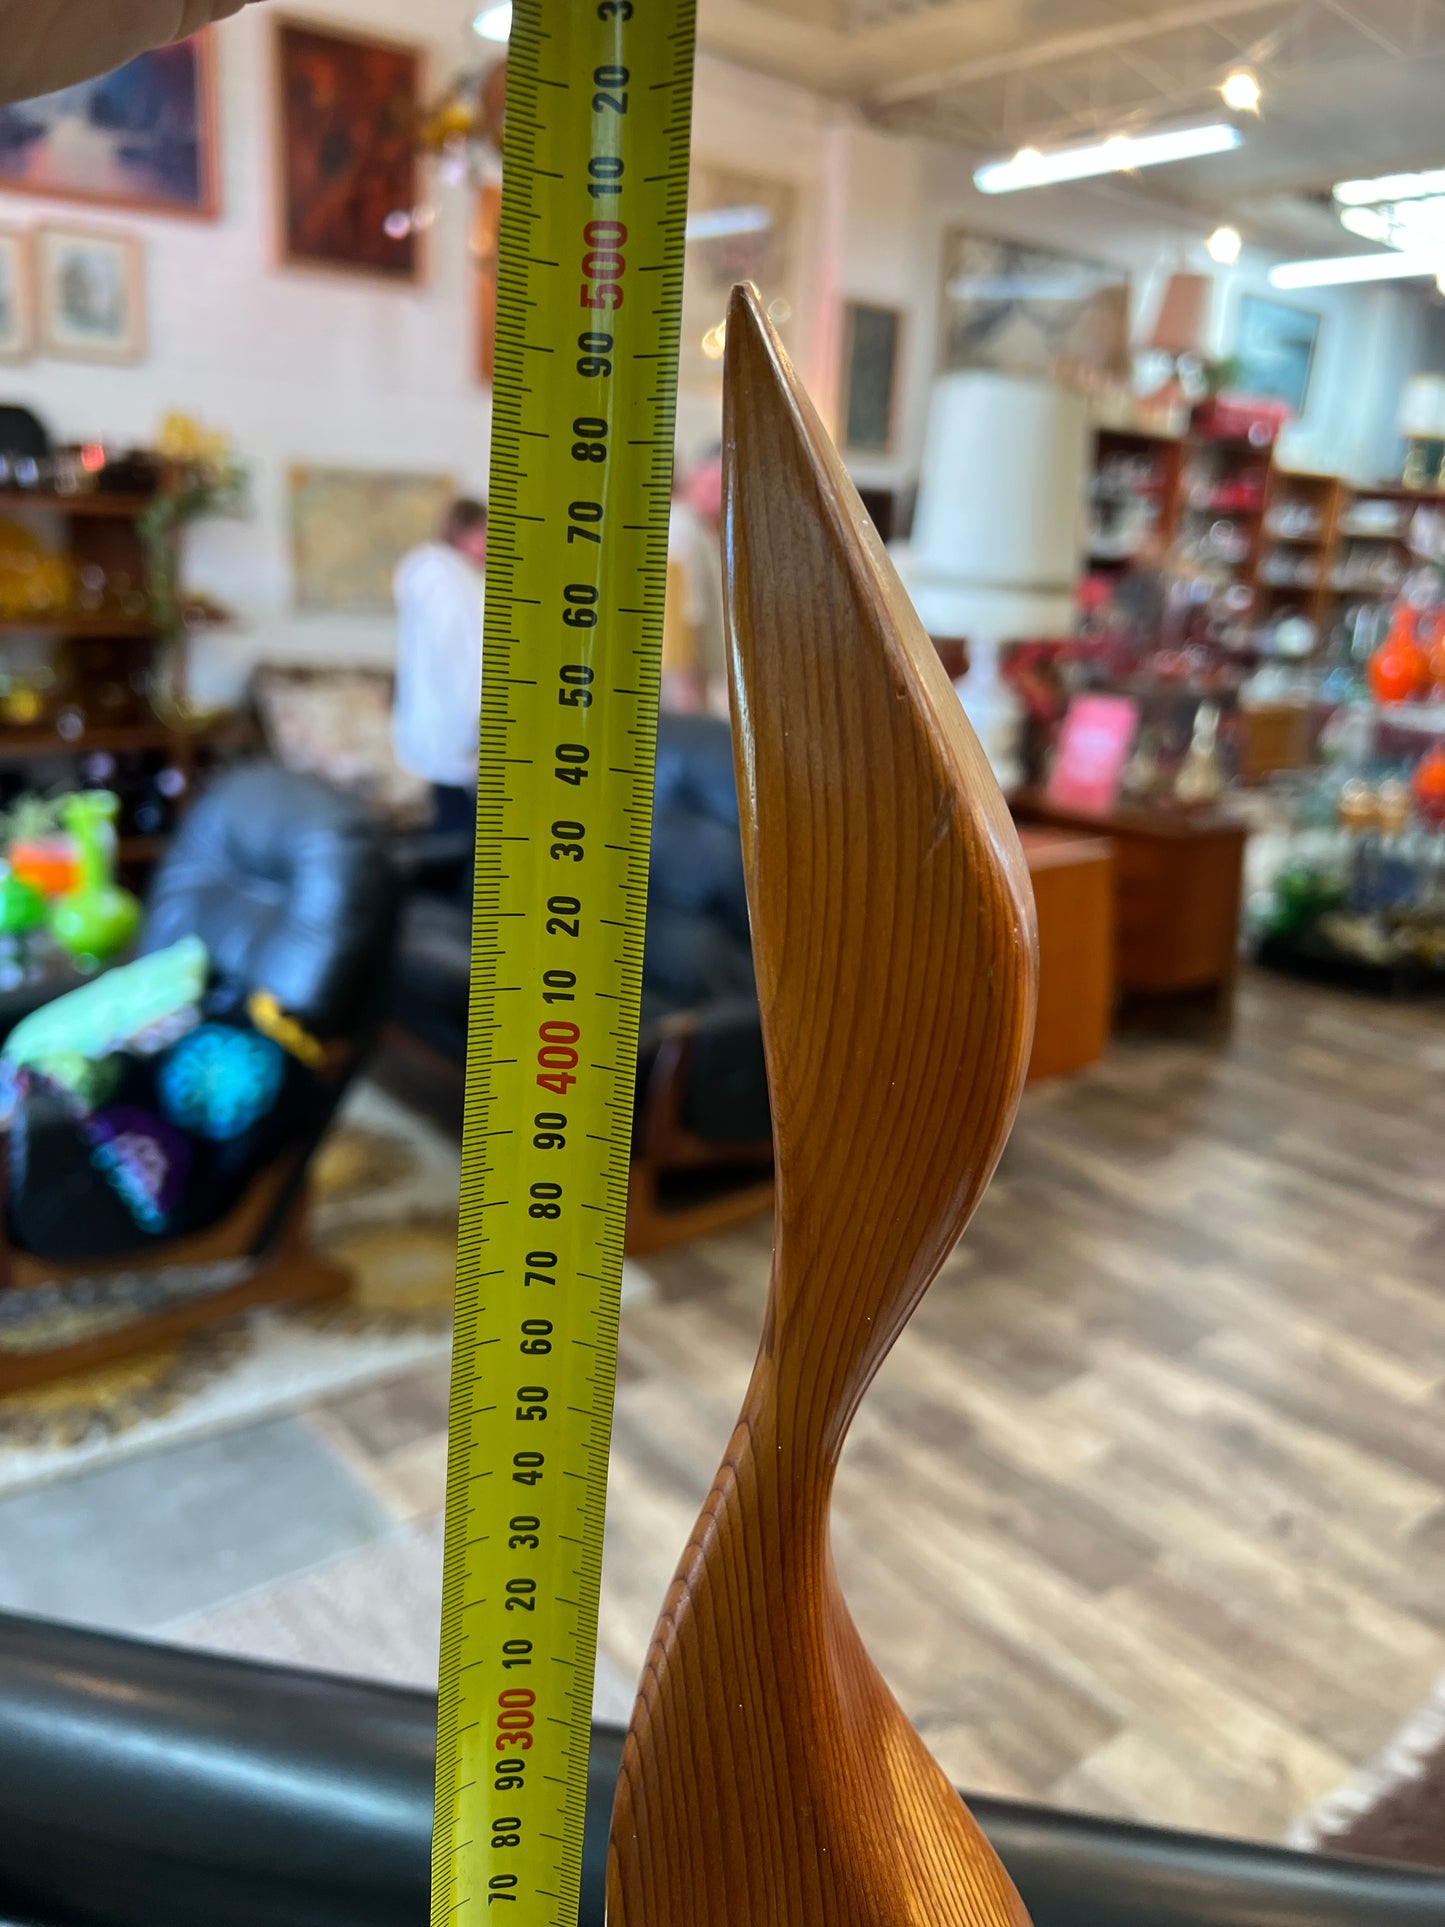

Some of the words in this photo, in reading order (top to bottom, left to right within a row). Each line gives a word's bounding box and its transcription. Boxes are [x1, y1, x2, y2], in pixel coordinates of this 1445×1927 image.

[592, 65, 630, 114] 20
[587, 156, 624, 198] 10
[580, 220, 628, 310] 500
[576, 332, 614, 378] 90
[571, 417, 608, 463] 80
[567, 501, 603, 543] 70
[562, 584, 599, 628] 60
[559, 665, 594, 707] 50
[555, 744, 590, 786] 40
[550, 821, 585, 862] 30
[546, 896, 581, 937] 20
[543, 970, 576, 1004] 10
[536, 1021, 580, 1095] 400
[533, 1113, 567, 1149] 90
[529, 1183, 562, 1219] 80
[525, 1252, 557, 1286] 70
[520, 1319, 553, 1354] 60
[516, 1386, 548, 1421] 50
[513, 1452, 544, 1485] 40
[509, 1516, 540, 1549] 30
[505, 1579, 536, 1611] 20
[502, 1640, 532, 1669] 10
[496, 1689, 537, 1750] 300
[495, 1758, 525, 1791] 90
[491, 1817, 521, 1848] 80
[489, 1875, 517, 1905] 70
